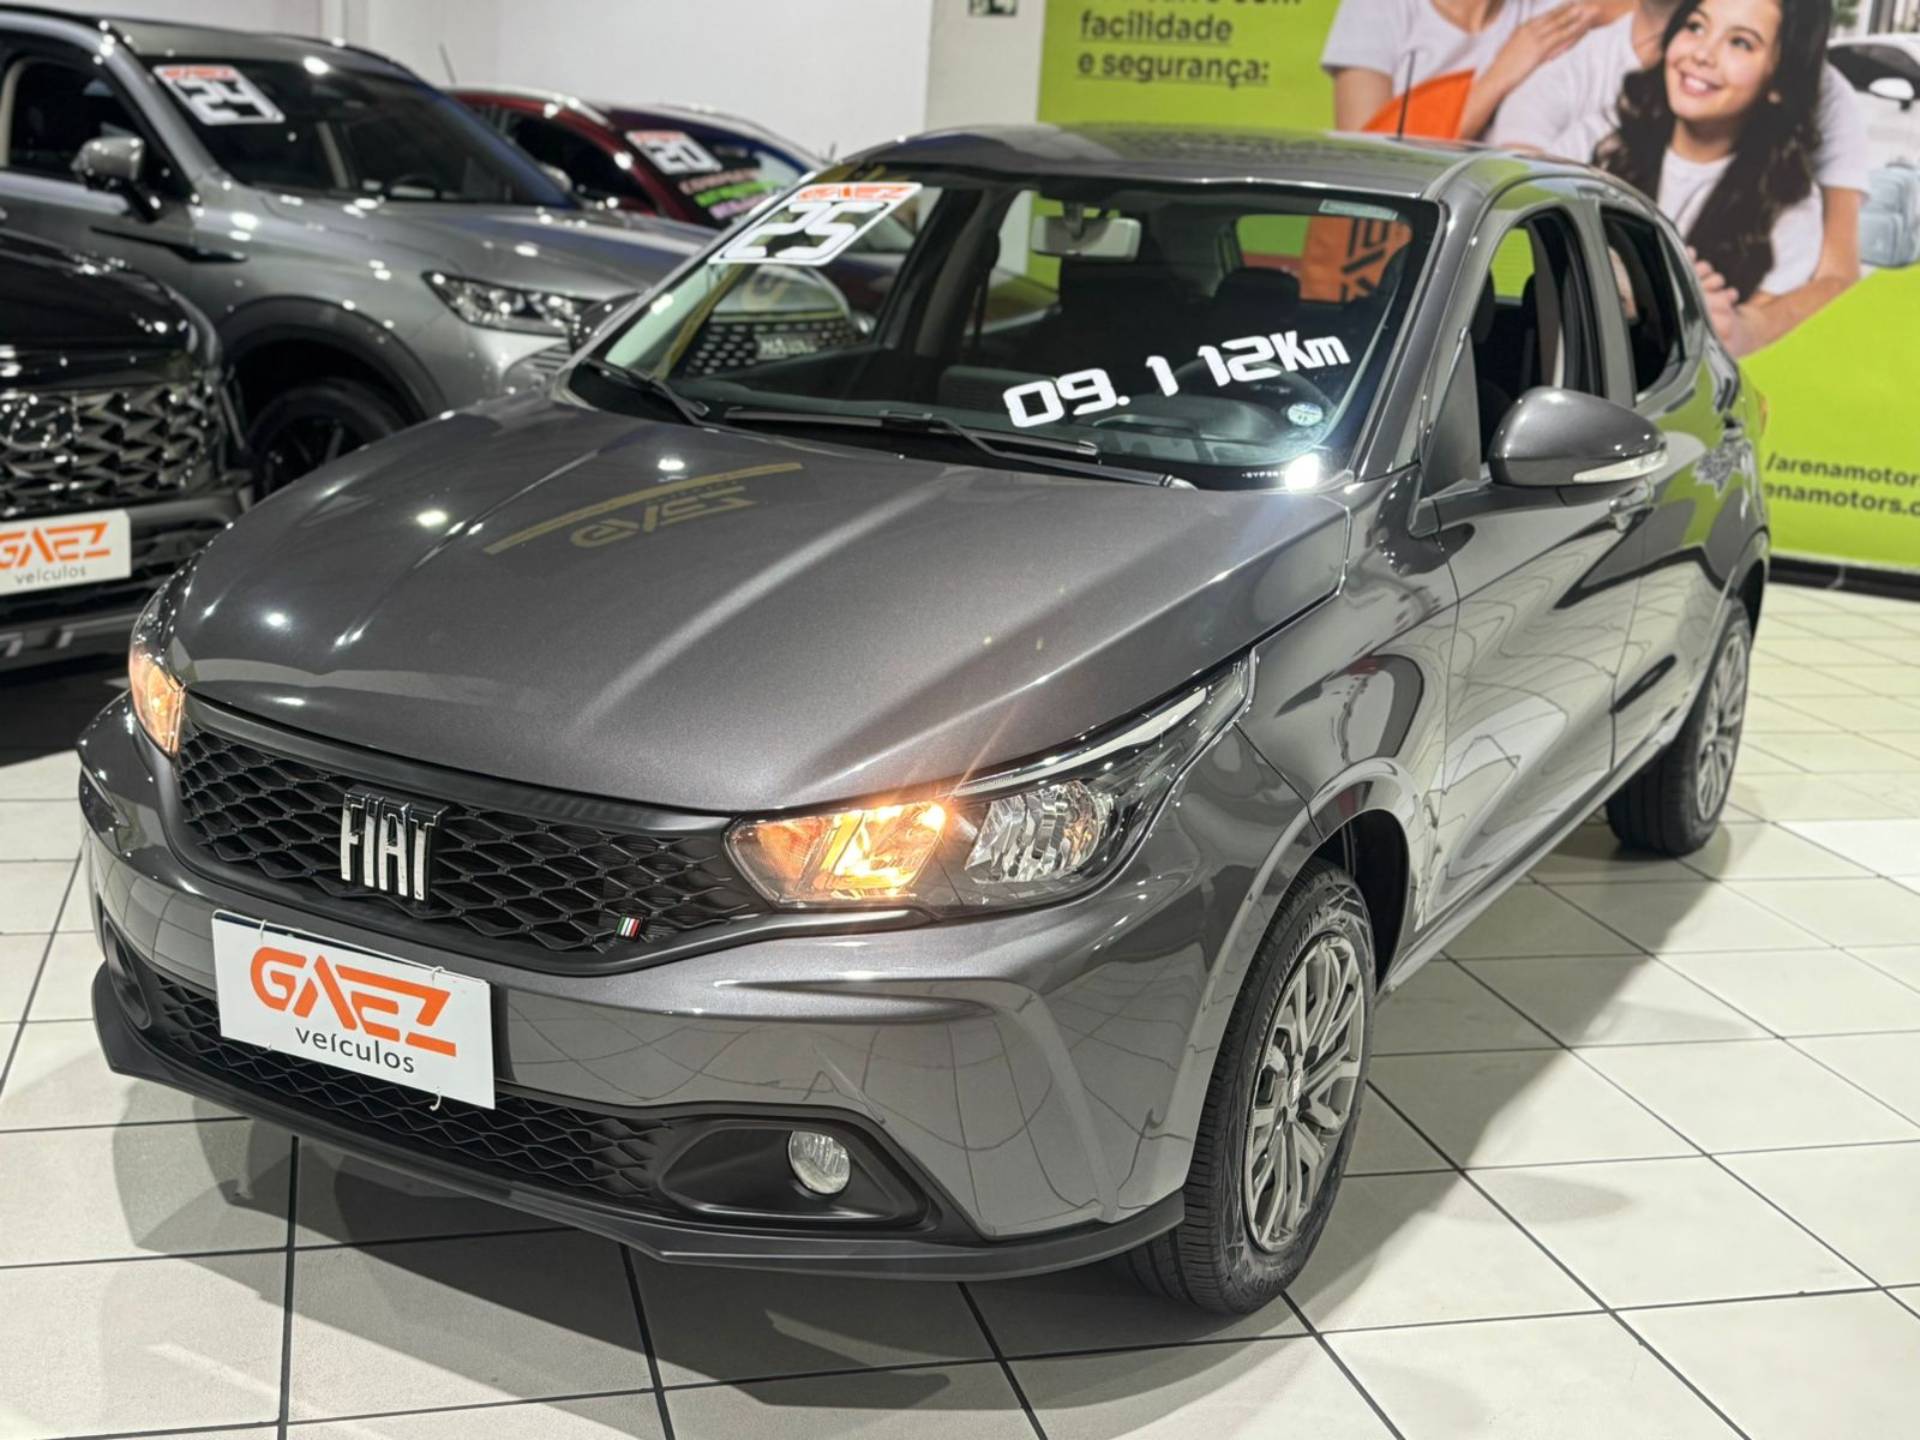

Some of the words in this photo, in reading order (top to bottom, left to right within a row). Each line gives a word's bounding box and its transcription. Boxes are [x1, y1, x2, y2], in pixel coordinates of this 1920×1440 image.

[1080, 9, 1233, 42] facilidade
[1077, 52, 1094, 75] e
[1102, 53, 1269, 88] segurança:
[720, 201, 888, 259] 25
[340, 795, 441, 900] FIAT
[250, 947, 457, 1057] GAEZ
[295, 1026, 415, 1074] veículos
